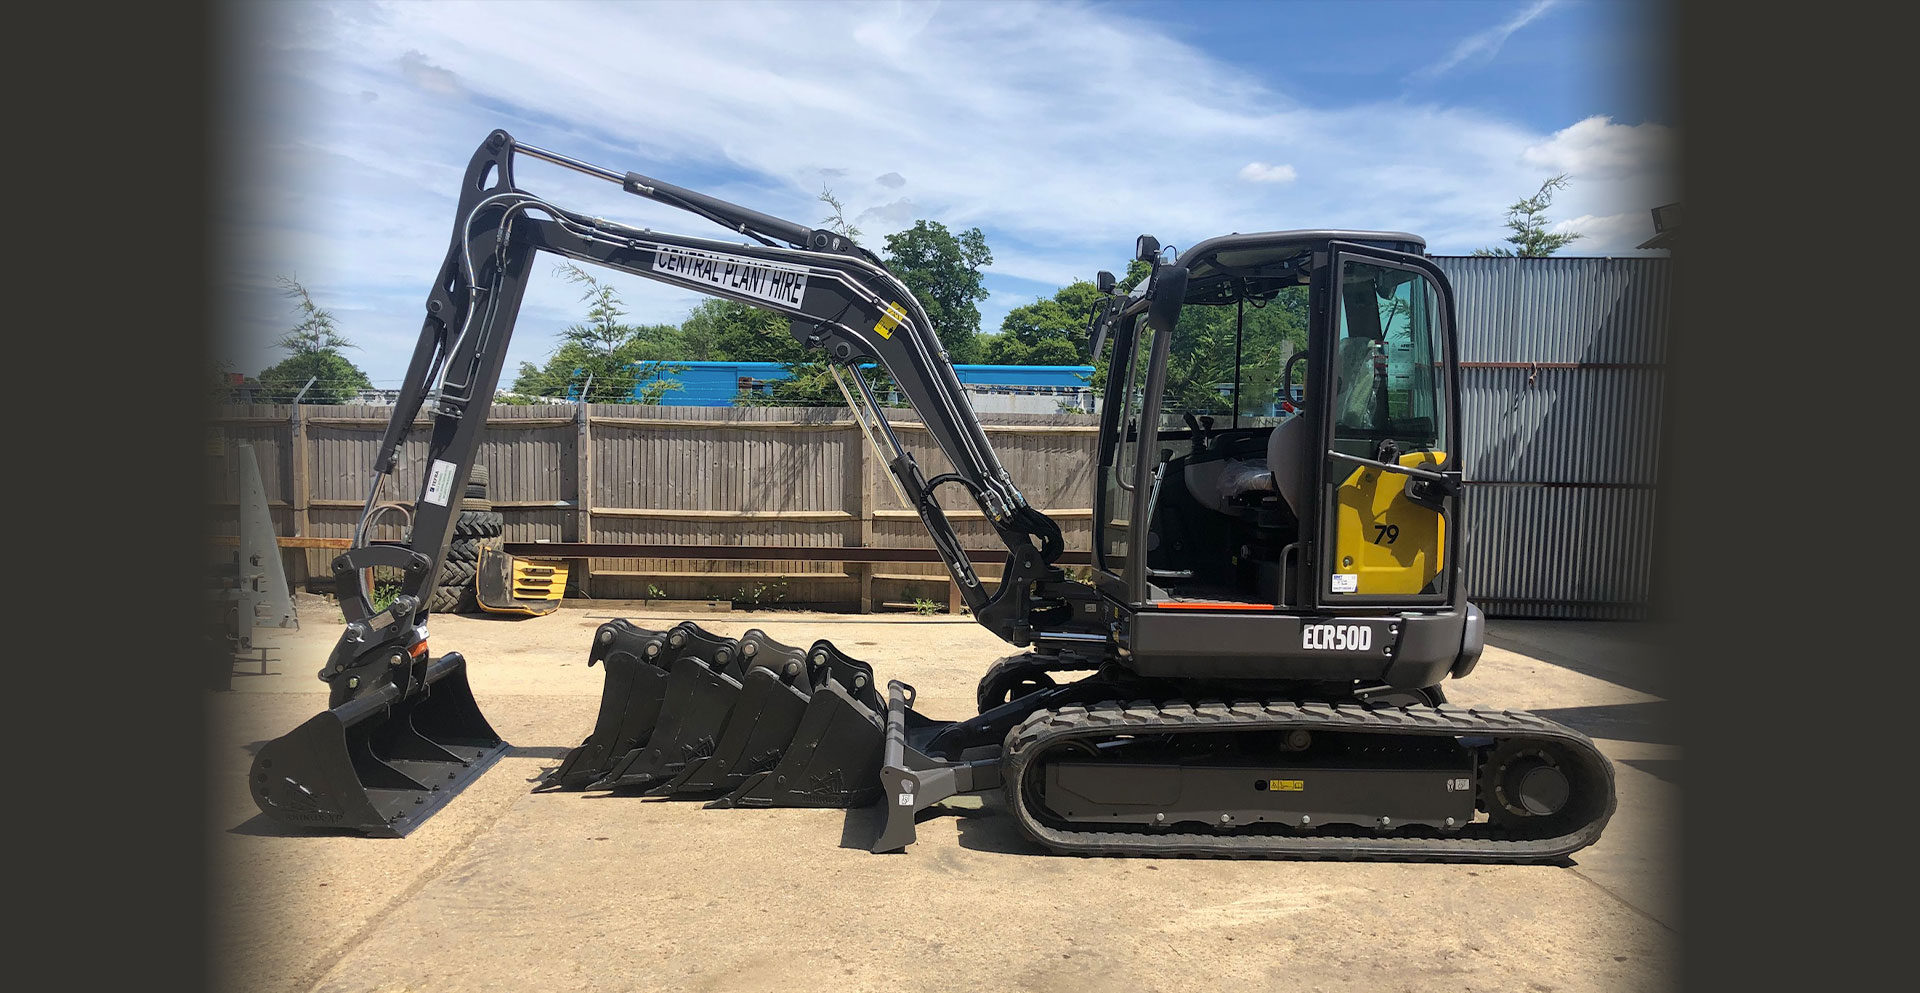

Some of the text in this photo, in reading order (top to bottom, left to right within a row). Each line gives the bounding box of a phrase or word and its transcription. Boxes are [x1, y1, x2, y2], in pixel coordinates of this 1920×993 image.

[658, 248, 806, 304] CENTRAL PLANT HIRE
[1373, 524, 1400, 545] 79
[1302, 624, 1372, 651] ECR50D
